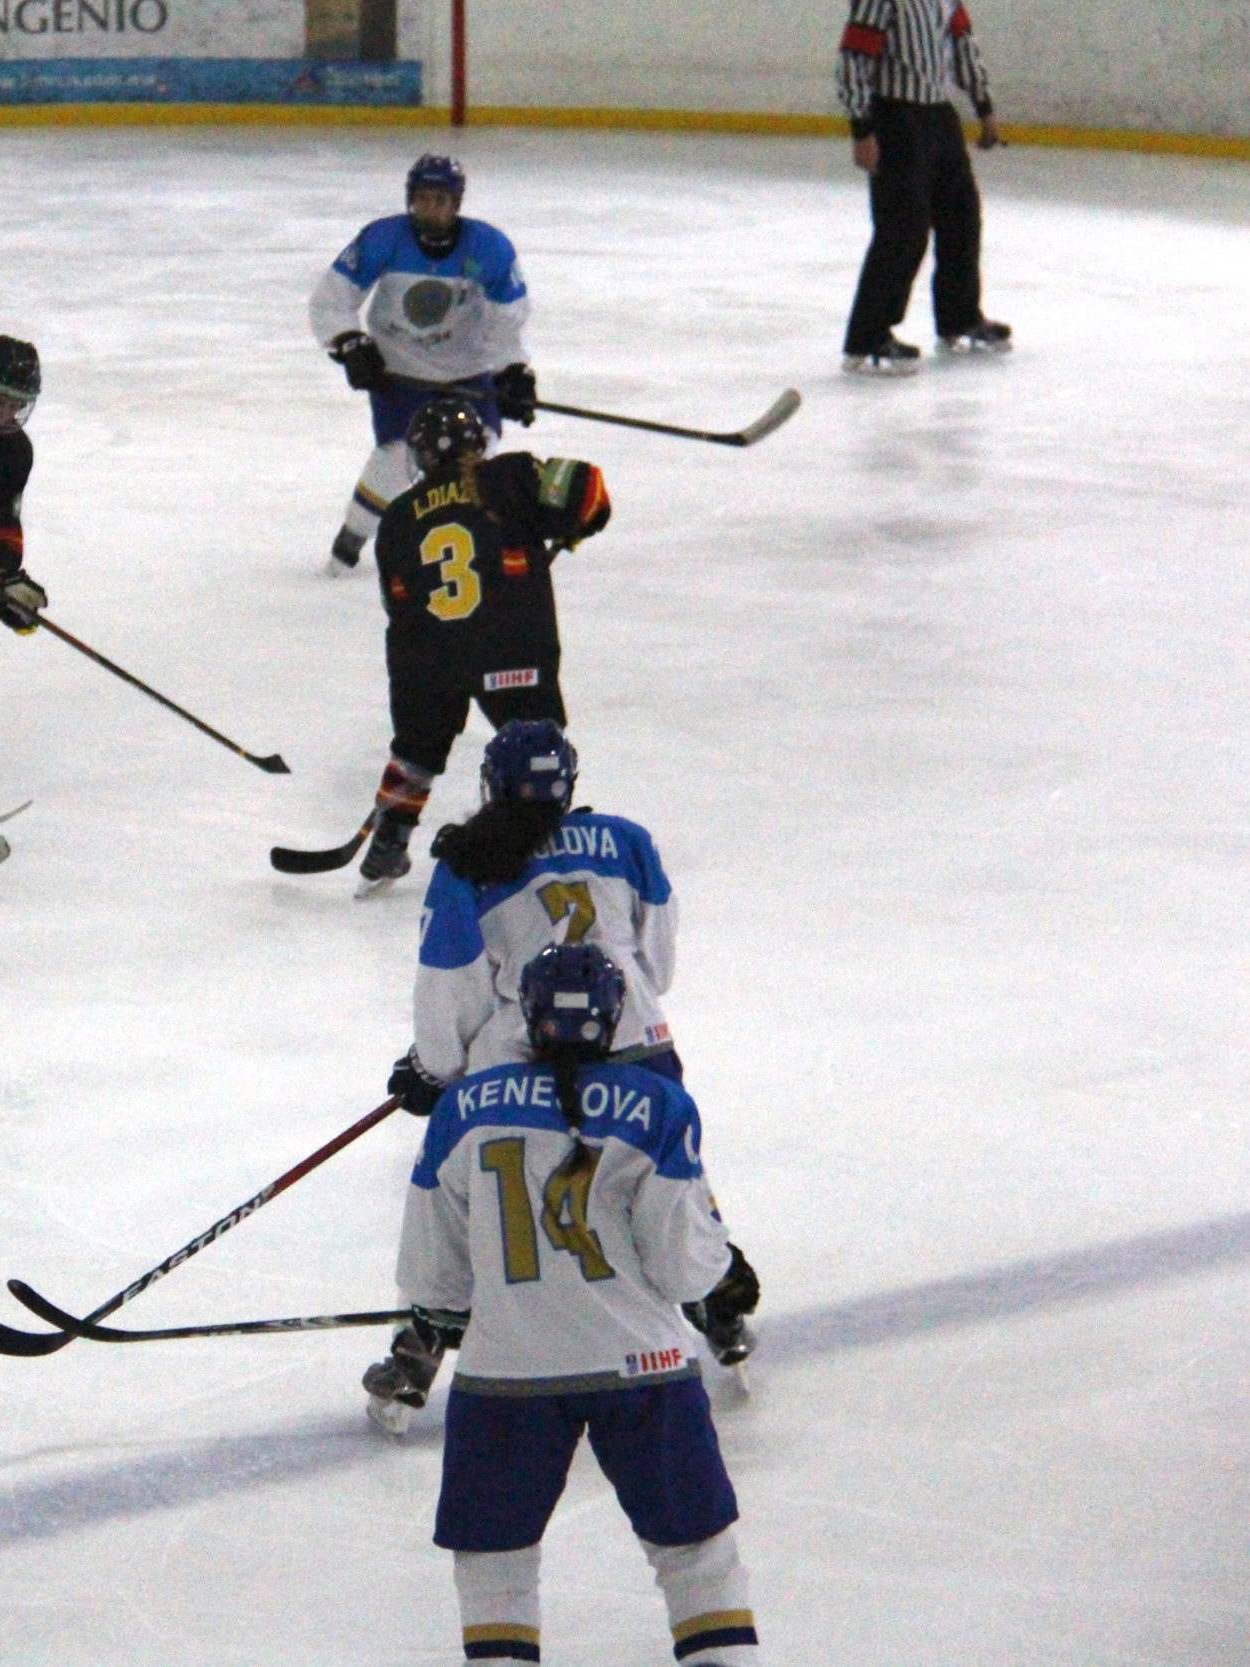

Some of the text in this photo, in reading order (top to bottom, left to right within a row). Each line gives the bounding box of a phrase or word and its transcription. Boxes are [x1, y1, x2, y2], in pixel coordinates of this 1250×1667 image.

[420, 522, 482, 622] 3
[457, 1075, 652, 1130] KENEOVA
[479, 1136, 617, 1285] 14
[640, 1348, 682, 1373] IIHF
